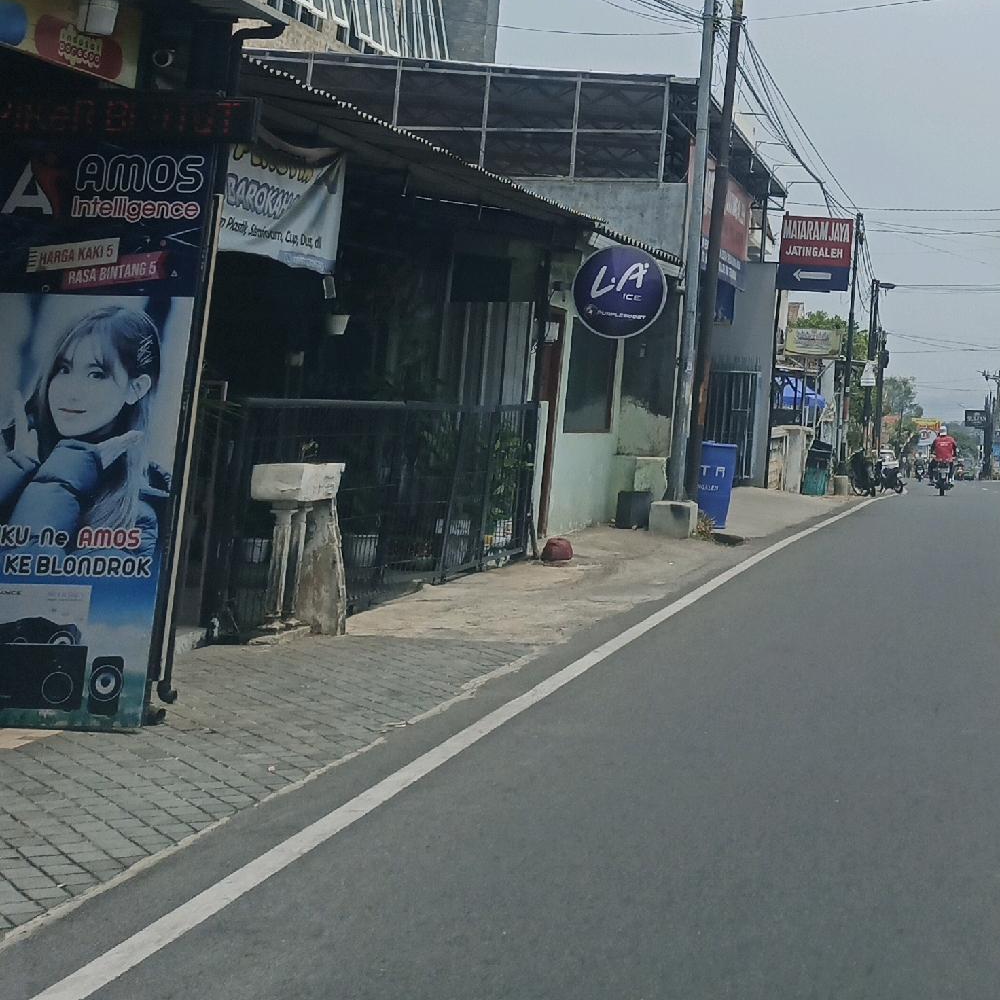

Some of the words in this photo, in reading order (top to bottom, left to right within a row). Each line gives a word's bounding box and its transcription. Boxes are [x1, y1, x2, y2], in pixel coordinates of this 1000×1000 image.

[75, 153, 205, 194] AMOS
[71, 195, 201, 223] Intelligence
[783, 219, 829, 241] MATARAM
[829, 222, 850, 243] JAYA
[39, 248, 75, 267] HARGA
[77, 245, 104, 262] KAKI
[106, 244, 114, 258] 5
[785, 245, 843, 259] JATINGALEH
[68, 268, 97, 285] RASA
[99, 262, 147, 281] BINTANG
[148, 261, 157, 275] 5
[77, 526, 142, 549] AMOS
[4, 553, 33, 576] KE
[35, 554, 153, 578] BLONDROK
